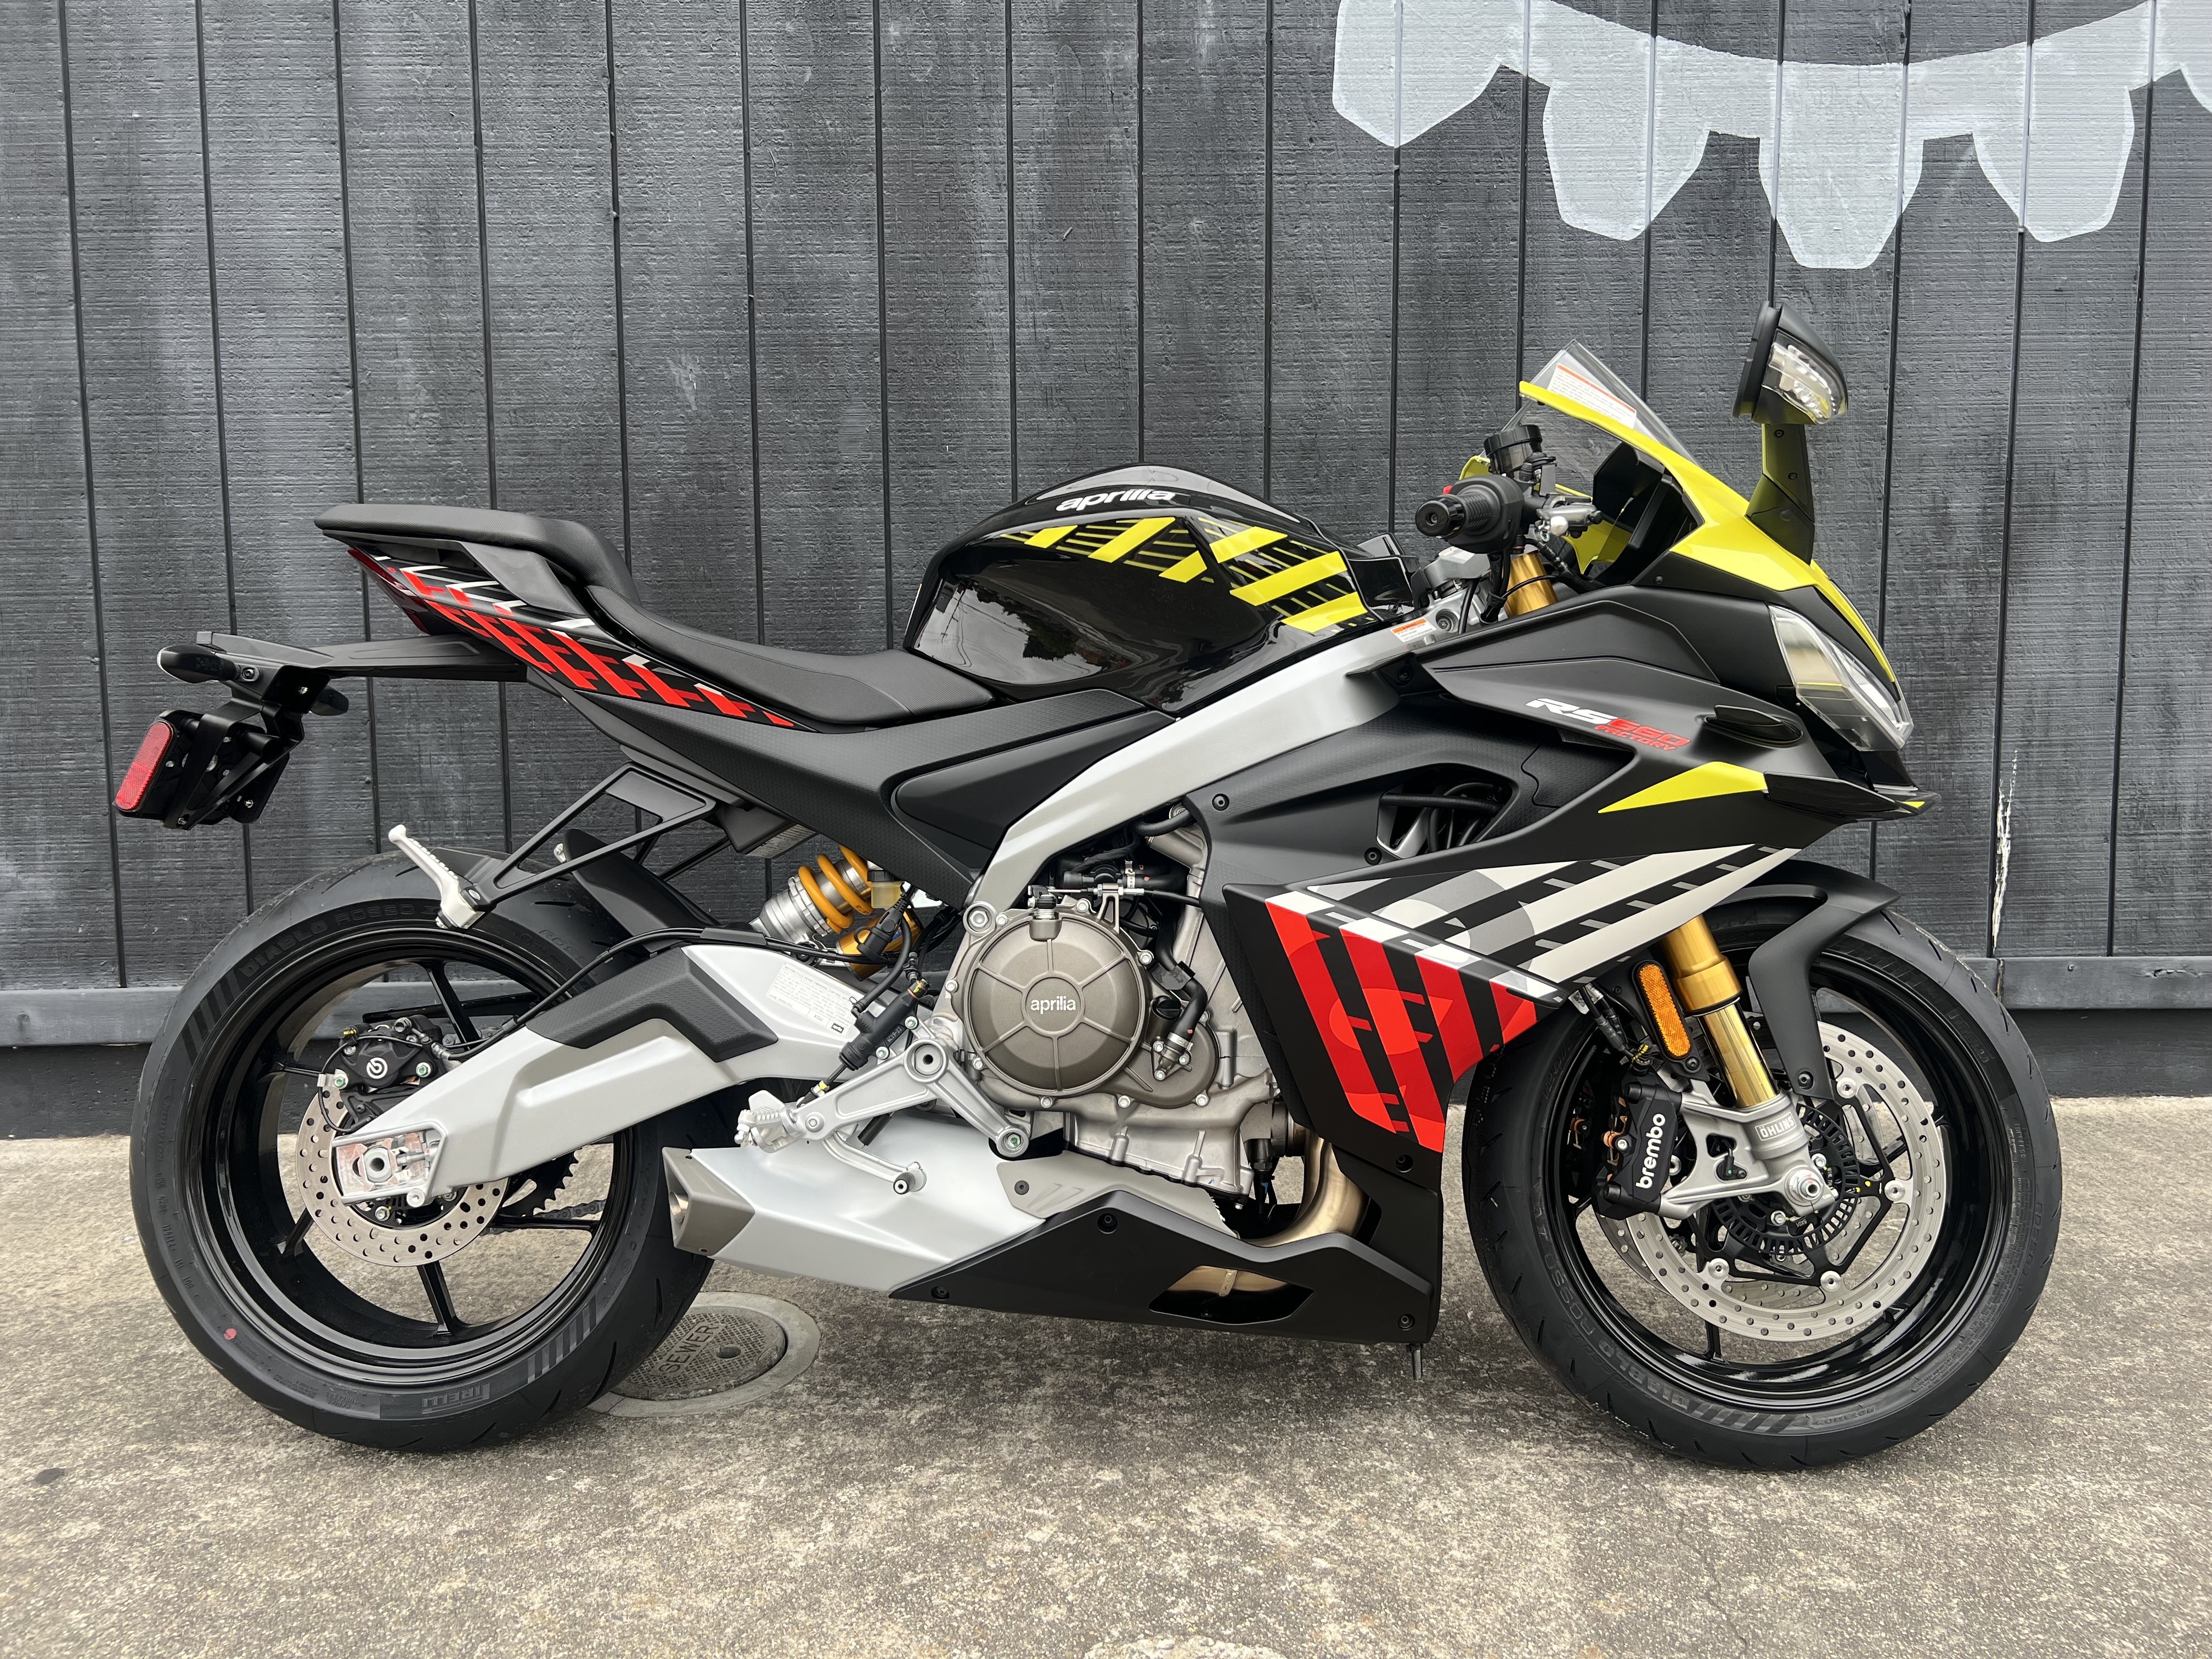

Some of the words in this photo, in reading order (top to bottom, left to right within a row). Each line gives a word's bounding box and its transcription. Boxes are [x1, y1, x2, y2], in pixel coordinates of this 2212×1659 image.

[1056, 488, 1176, 512] aprilia
[239, 918, 329, 978] DIABLO
[335, 903, 415, 926] ROSSO
[1030, 995, 1076, 1014] aprilia
[1635, 1113, 1666, 1189] brembo
[1759, 1115, 1795, 1138] ÖHLINS
[1543, 1252, 1595, 1336] ROSSO
[658, 1324, 719, 1373] SEWER
[1596, 1337, 1692, 1410] DIABLO
[421, 1383, 491, 1414] PIRELLI
